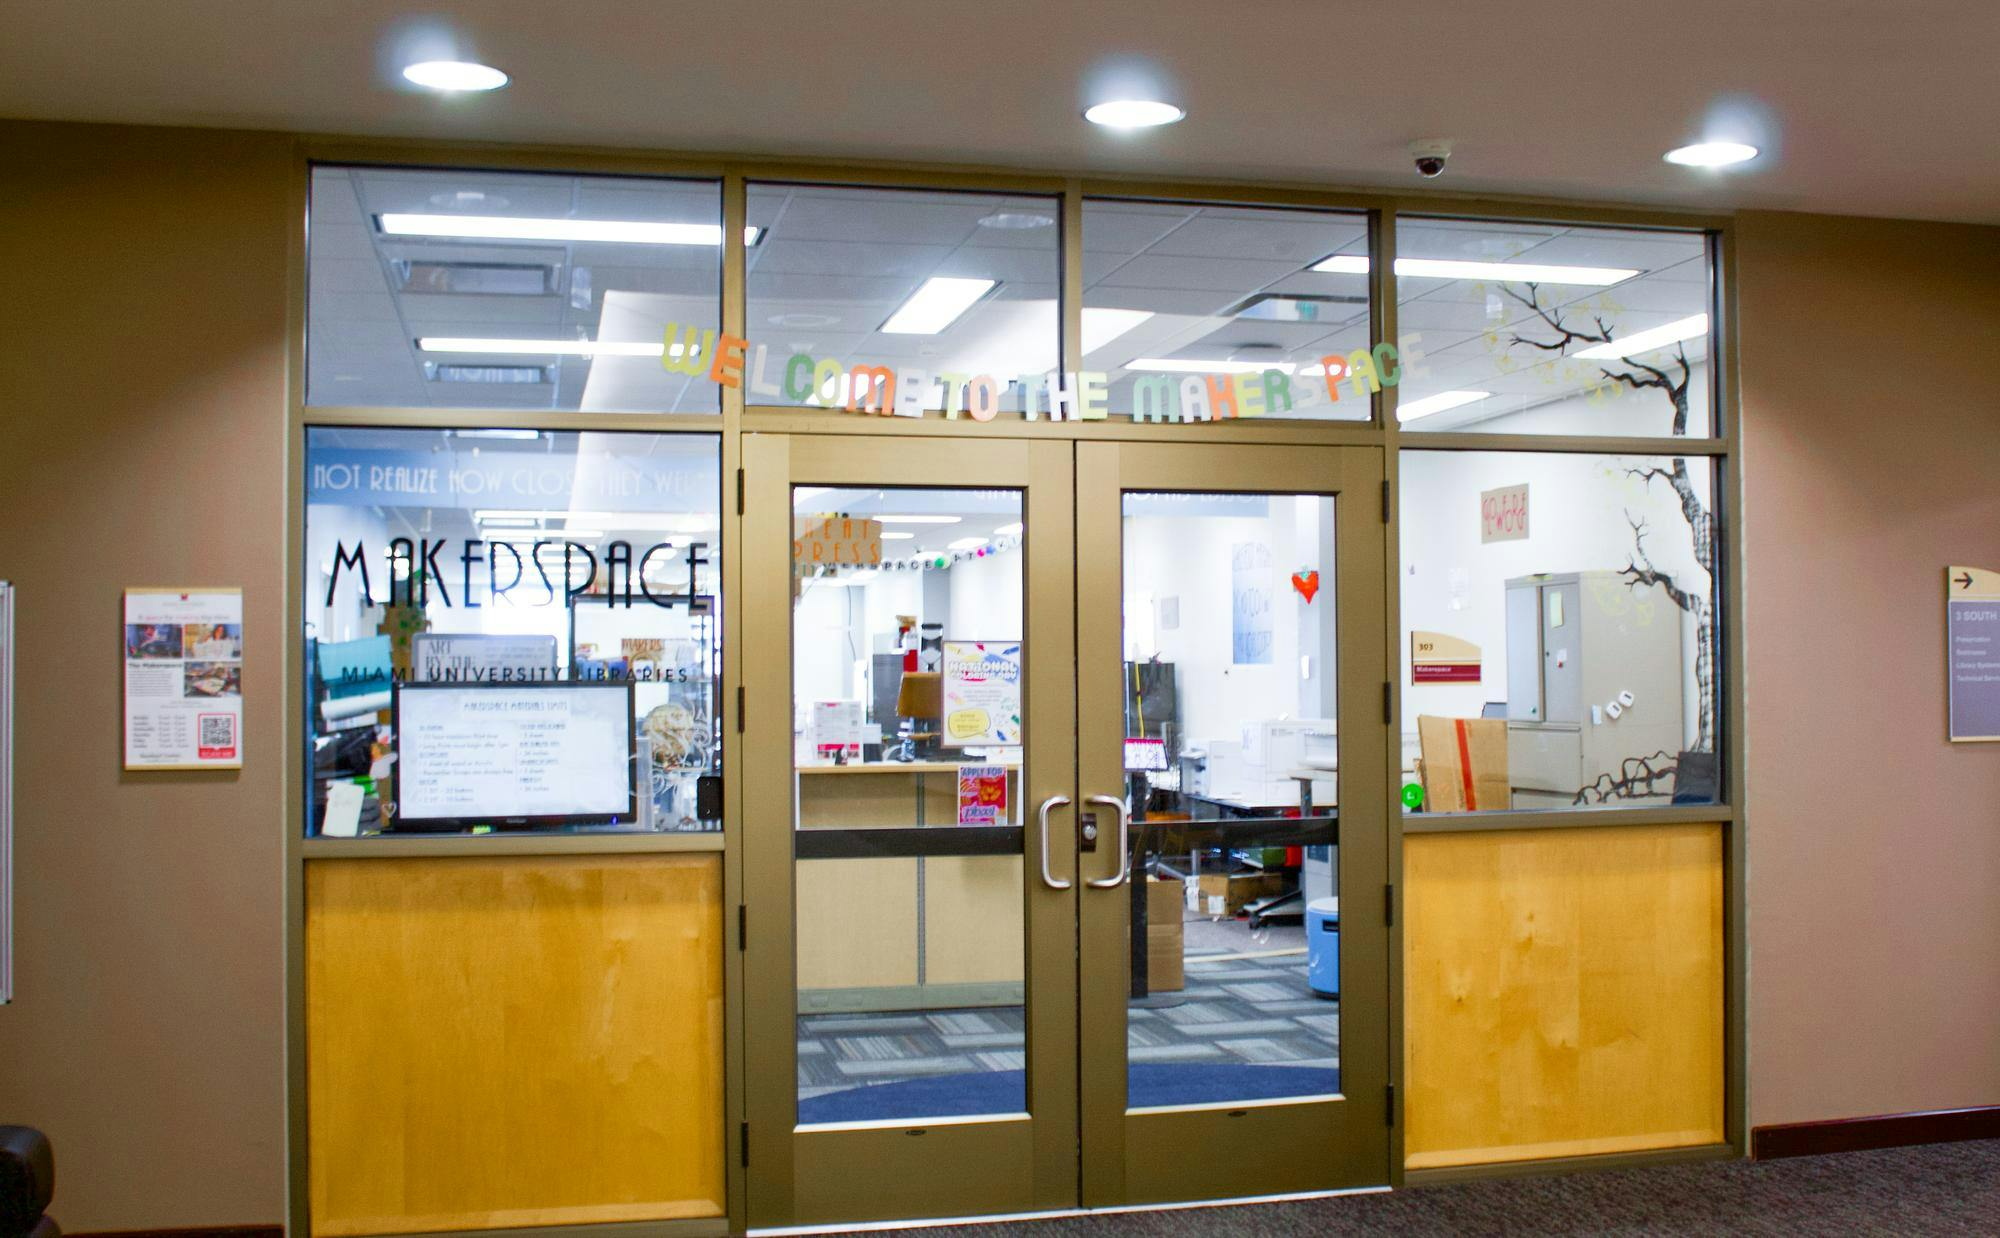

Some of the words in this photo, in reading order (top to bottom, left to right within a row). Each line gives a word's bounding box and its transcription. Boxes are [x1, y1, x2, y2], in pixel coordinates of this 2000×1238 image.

[660, 322, 926, 418] WELCOME
[932, 372, 998, 422] TO
[1017, 371, 1107, 422] THE
[314, 464, 360, 490] NOT
[370, 467, 438, 495] REALIZE
[448, 469, 501, 495] HOW
[511, 469, 578, 497] CLOS
[325, 537, 709, 609] MAKERSPACE
[1963, 611, 1998, 621] SOUTH
[1419, 643, 1434, 651] 303
[342, 666, 415, 682] MIAMI
[429, 667, 562, 682] UNIVERSITY
[576, 667, 688, 683] LIBRARIES
